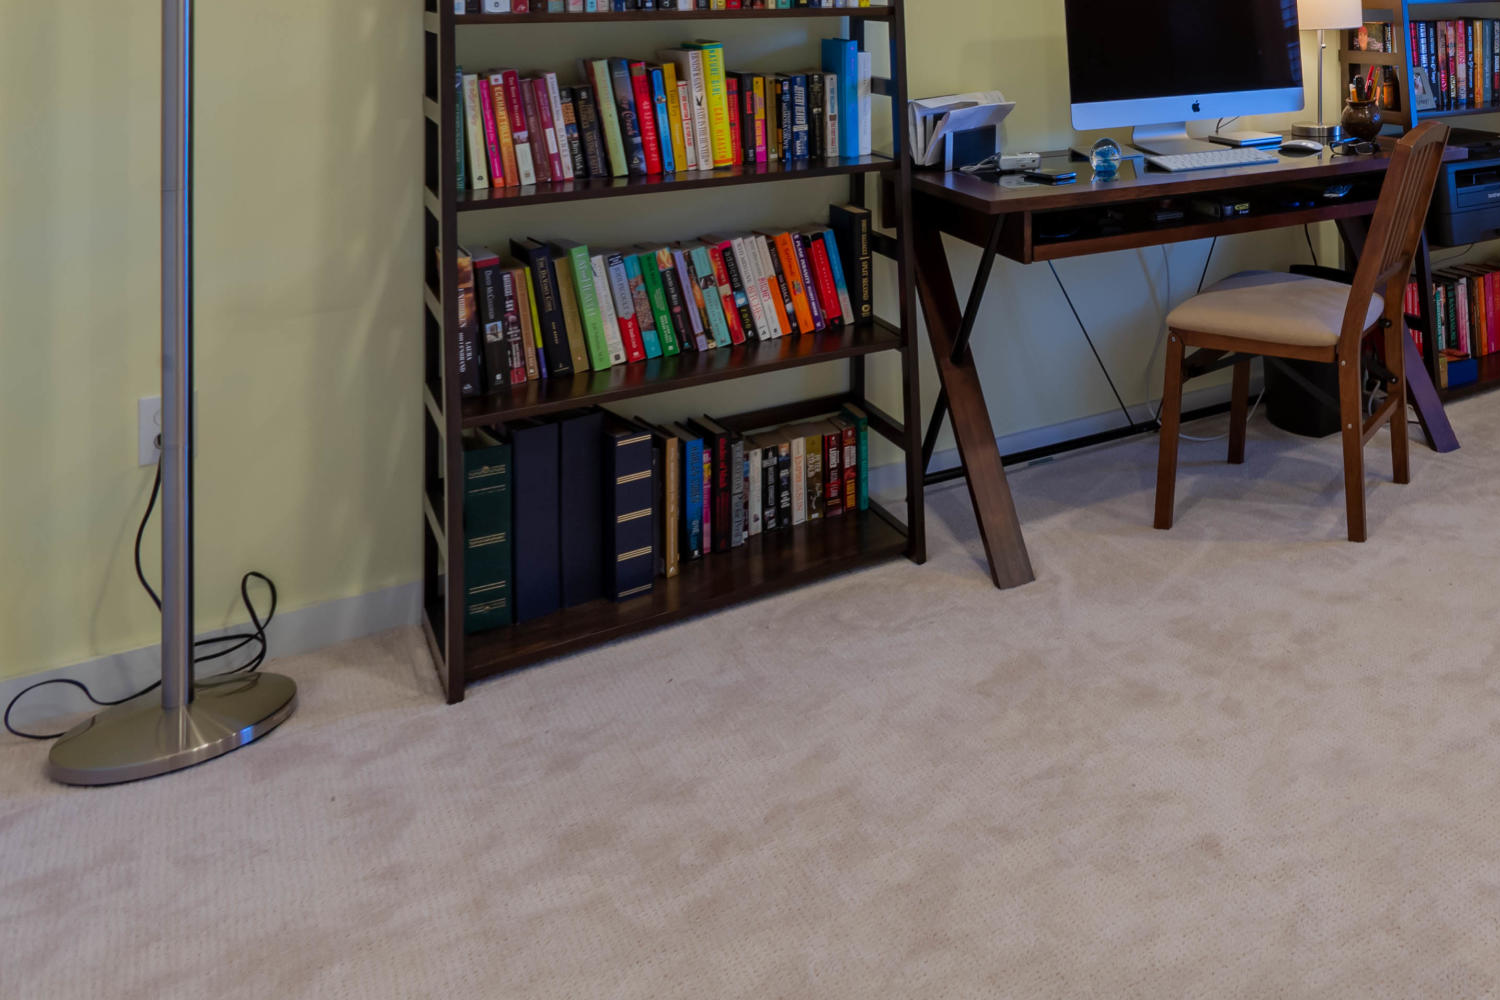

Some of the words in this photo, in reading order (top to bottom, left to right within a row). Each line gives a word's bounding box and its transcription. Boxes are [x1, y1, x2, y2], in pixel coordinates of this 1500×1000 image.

[709, 50, 720, 76] NATURE
[712, 80, 721, 96] GIRL
[794, 85, 805, 106] JEFFERY
[494, 86, 506, 121] ECKHART
[500, 122, 510, 143] TOLLE
[622, 110, 636, 136] Creek
[713, 107, 724, 125] CARL
[795, 106, 806, 124] DEAVER
[715, 129, 726, 159] HIAASEN
[724, 251, 740, 288] addicted
[800, 259, 811, 284] INSANITY
[542, 279, 550, 296] VINCI
[780, 283, 790, 303] SHACK
[458, 288, 467, 328] UNBROKEN
[544, 296, 553, 312] CODE
[746, 285, 762, 320] BITCHES
[458, 332, 466, 373] HILLENBRAND
